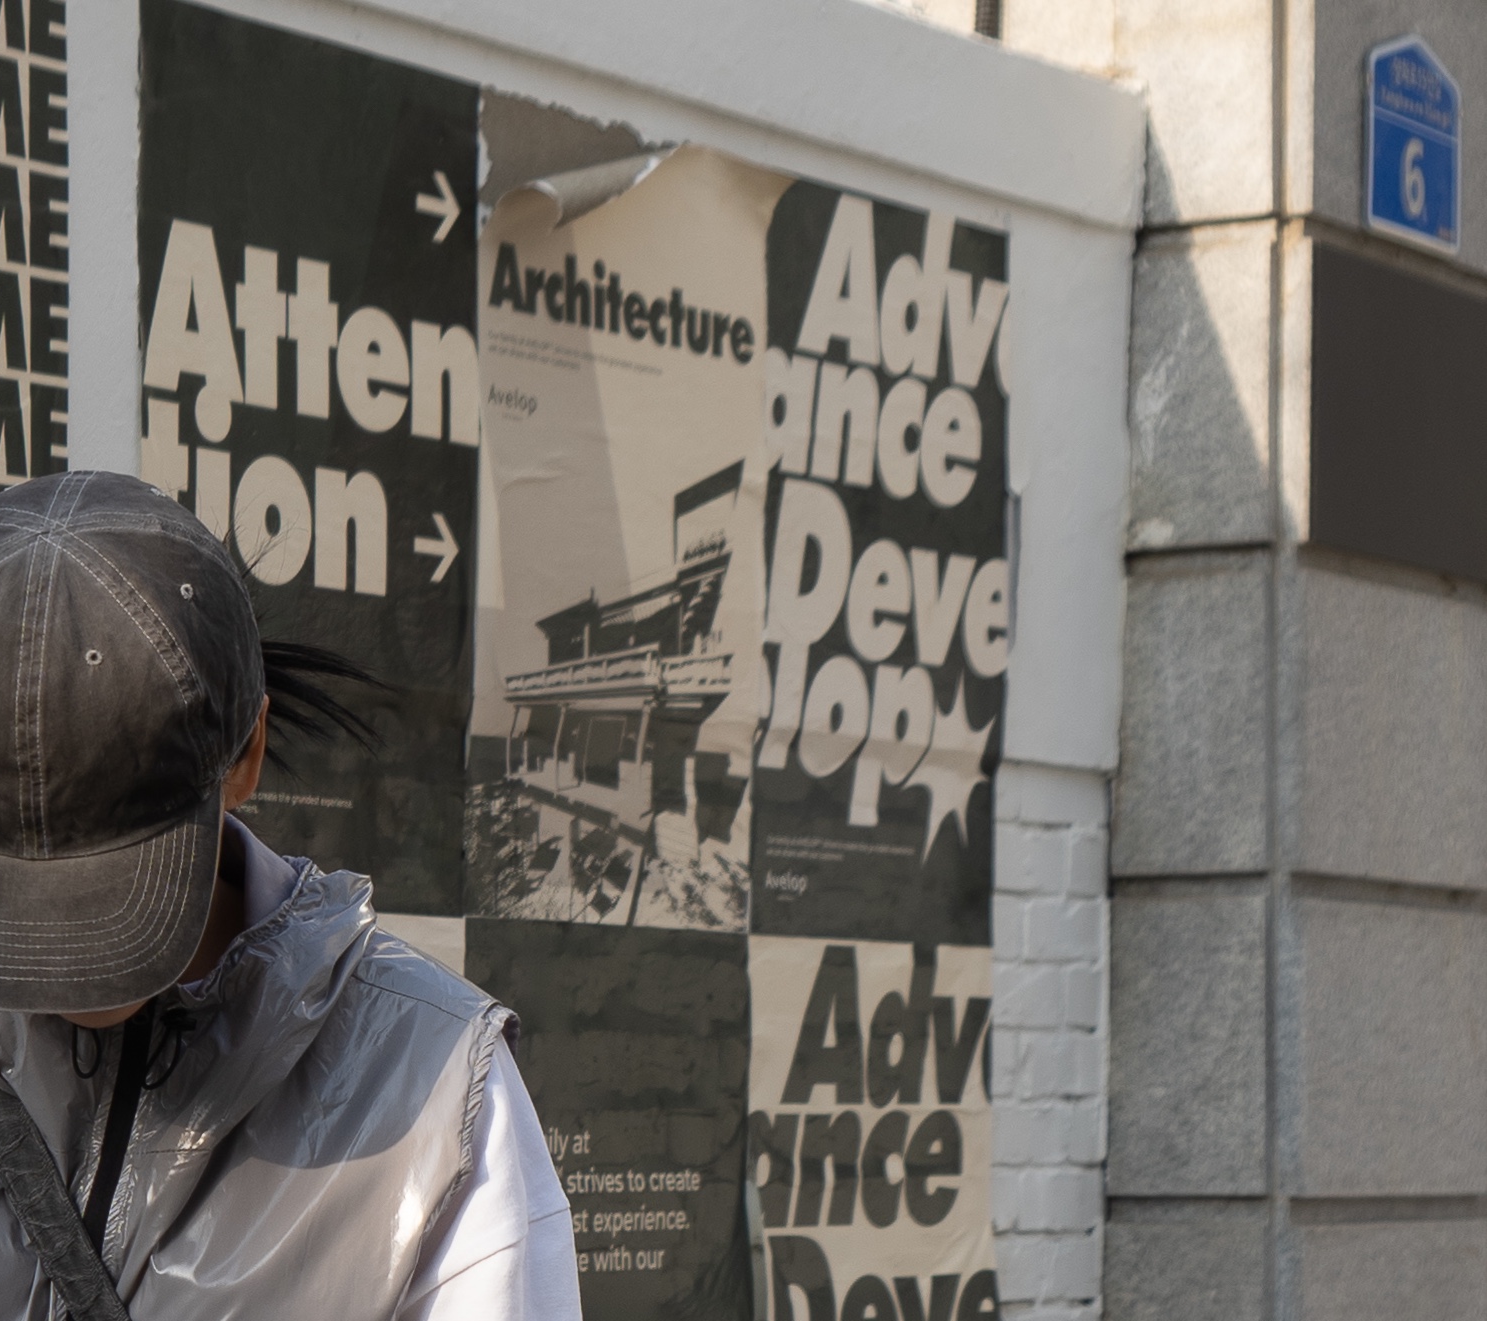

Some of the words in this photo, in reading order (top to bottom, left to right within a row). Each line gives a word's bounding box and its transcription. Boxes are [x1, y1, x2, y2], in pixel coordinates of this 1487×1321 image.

[1401, 138, 1426, 219] 6
[143, 219, 480, 447] Atten
[488, 241, 755, 365] Architecture
[796, 193, 1010, 396] Adv
[765, 346, 982, 508] ance
[766, 475, 1009, 678] Deve
[780, 943, 993, 1108] Adv
[566, 1166, 624, 1194] strives
[627, 1169, 645, 1193] to
[649, 1167, 701, 1192] create
[572, 1130, 591, 1154] at
[747, 1109, 963, 1228] ance
[593, 1203, 690, 1238] experience.
[593, 1244, 632, 1272] with
[635, 1249, 664, 1271] our
